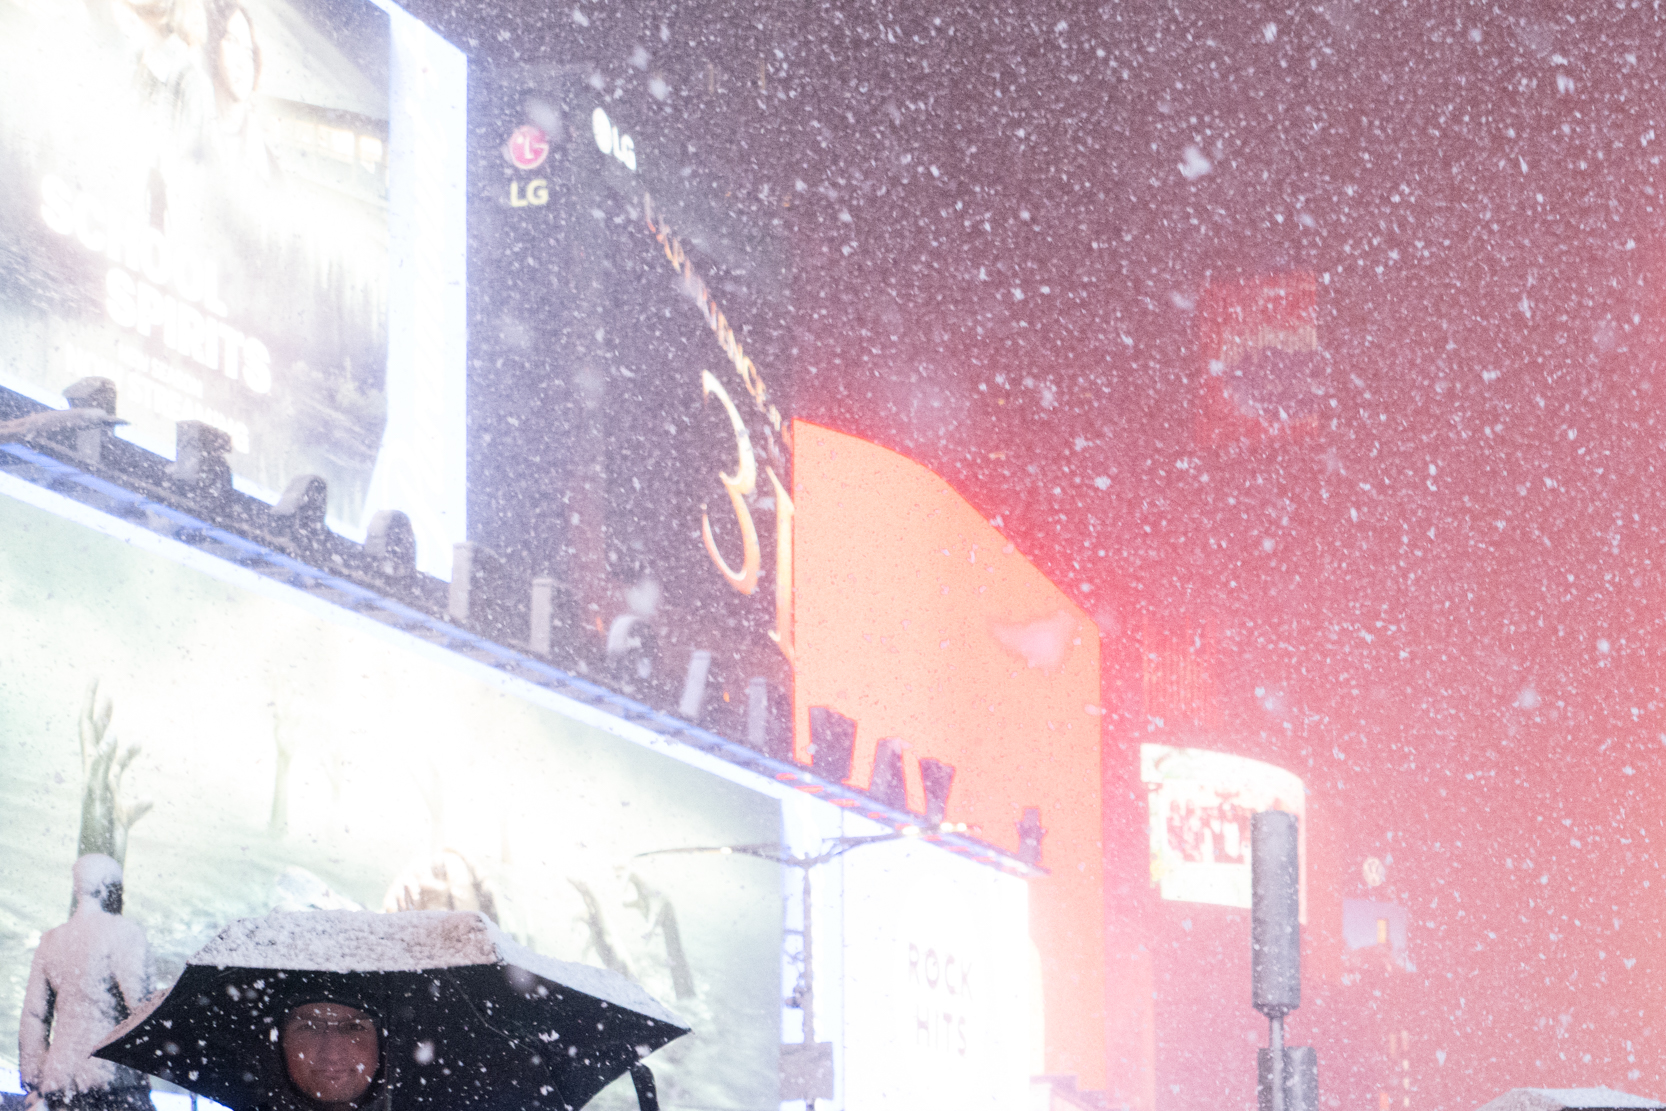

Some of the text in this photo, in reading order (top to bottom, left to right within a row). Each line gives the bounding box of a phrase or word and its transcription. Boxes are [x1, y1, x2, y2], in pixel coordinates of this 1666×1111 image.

[611, 125, 637, 171] LG
[510, 178, 550, 208] LG
[40, 174, 229, 317] SCHOOL
[105, 266, 272, 395] SPIRITS
[907, 941, 975, 1001] ROCK
[914, 1003, 969, 1059] HITS
